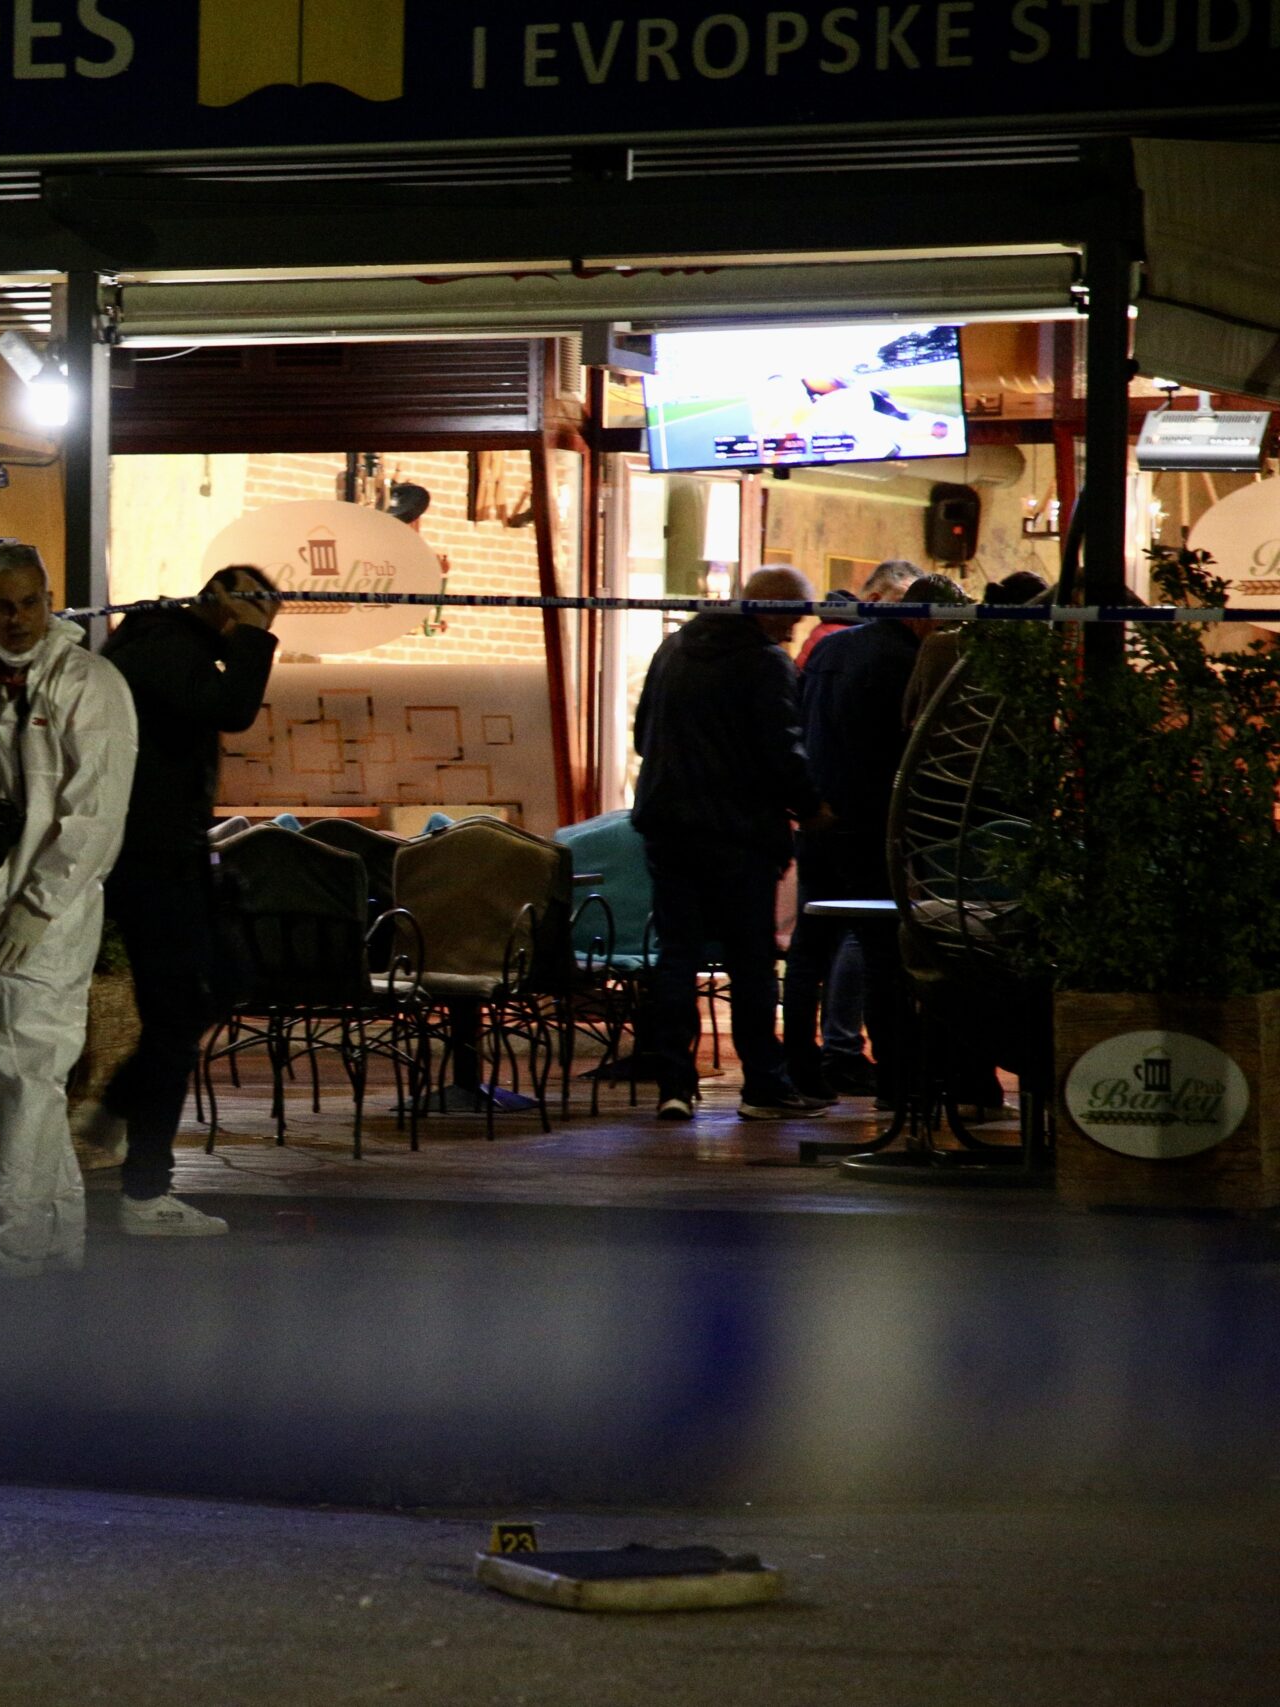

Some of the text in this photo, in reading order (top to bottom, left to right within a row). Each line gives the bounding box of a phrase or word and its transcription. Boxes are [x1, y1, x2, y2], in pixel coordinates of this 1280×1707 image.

[471, 25, 487, 90] I
[523, 1, 974, 88] EVROPSKE
[363, 560, 397, 577] Pub
[1088, 1078, 1224, 1125] Barley
